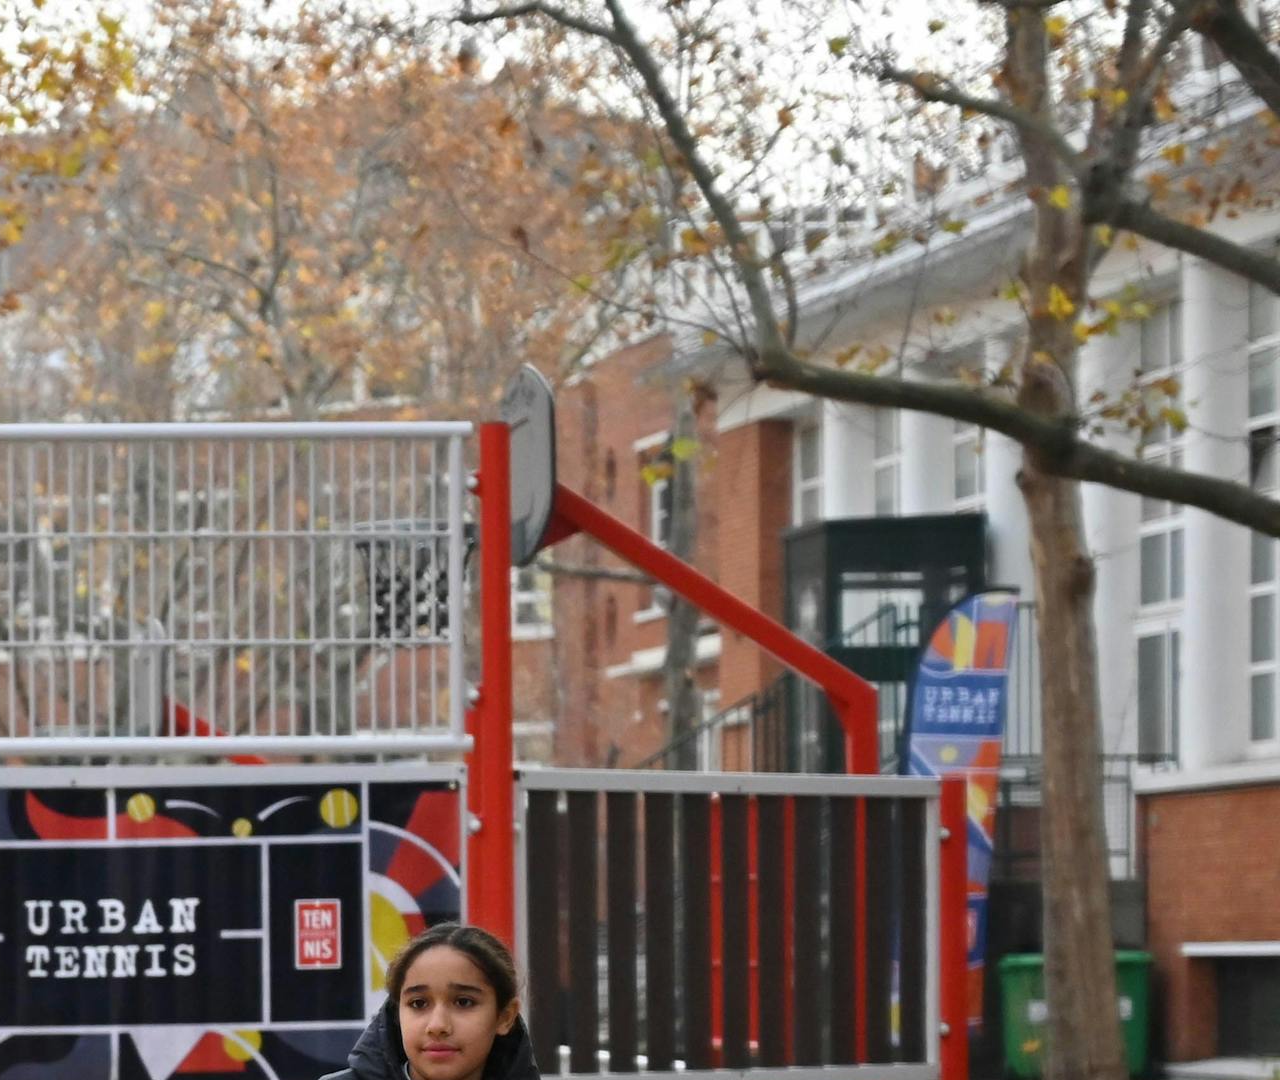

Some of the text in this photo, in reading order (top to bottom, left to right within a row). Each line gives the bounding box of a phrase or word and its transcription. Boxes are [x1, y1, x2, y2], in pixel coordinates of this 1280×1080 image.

[23, 897, 200, 935] URBAN
[303, 908, 333, 929] TEN
[25, 943, 196, 978] TENNIS
[303, 938, 333, 959] NIS
